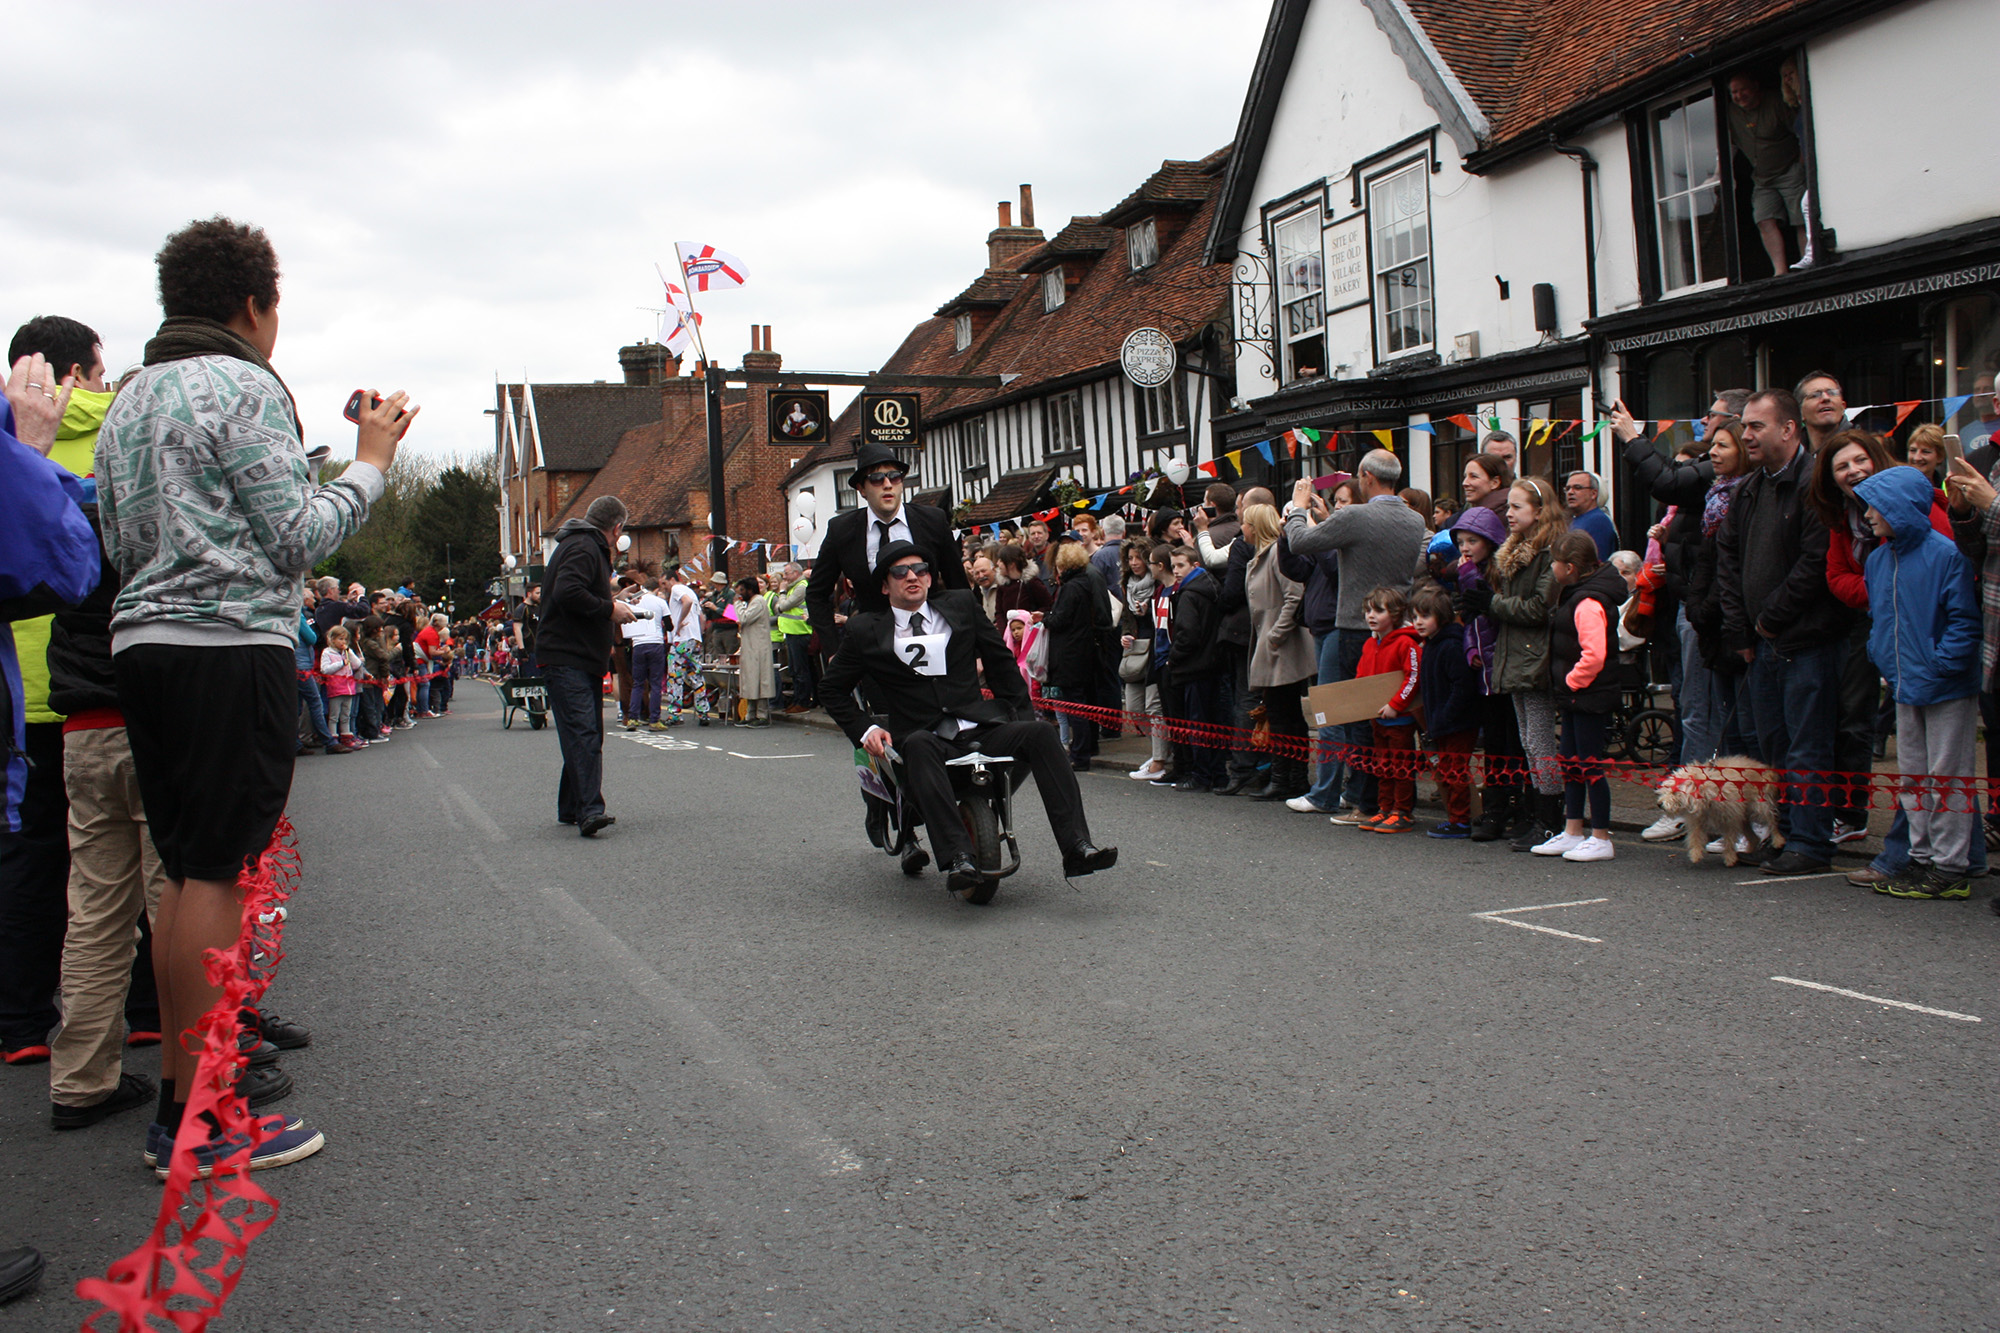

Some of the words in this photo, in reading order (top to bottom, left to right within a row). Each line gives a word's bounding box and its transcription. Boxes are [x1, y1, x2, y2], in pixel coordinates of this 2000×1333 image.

[1332, 234, 1347, 249] SITE
[1348, 230, 1358, 242] OF
[1331, 251, 1346, 265] THE
[1347, 245, 1361, 260] OLD
[1332, 261, 1361, 280] VILLAGE
[1333, 278, 1361, 296] BAKERY
[1130, 355, 1168, 363] EXPRESS
[1137, 348, 1161, 356] PIZZA
[905, 643, 928, 669] 2
